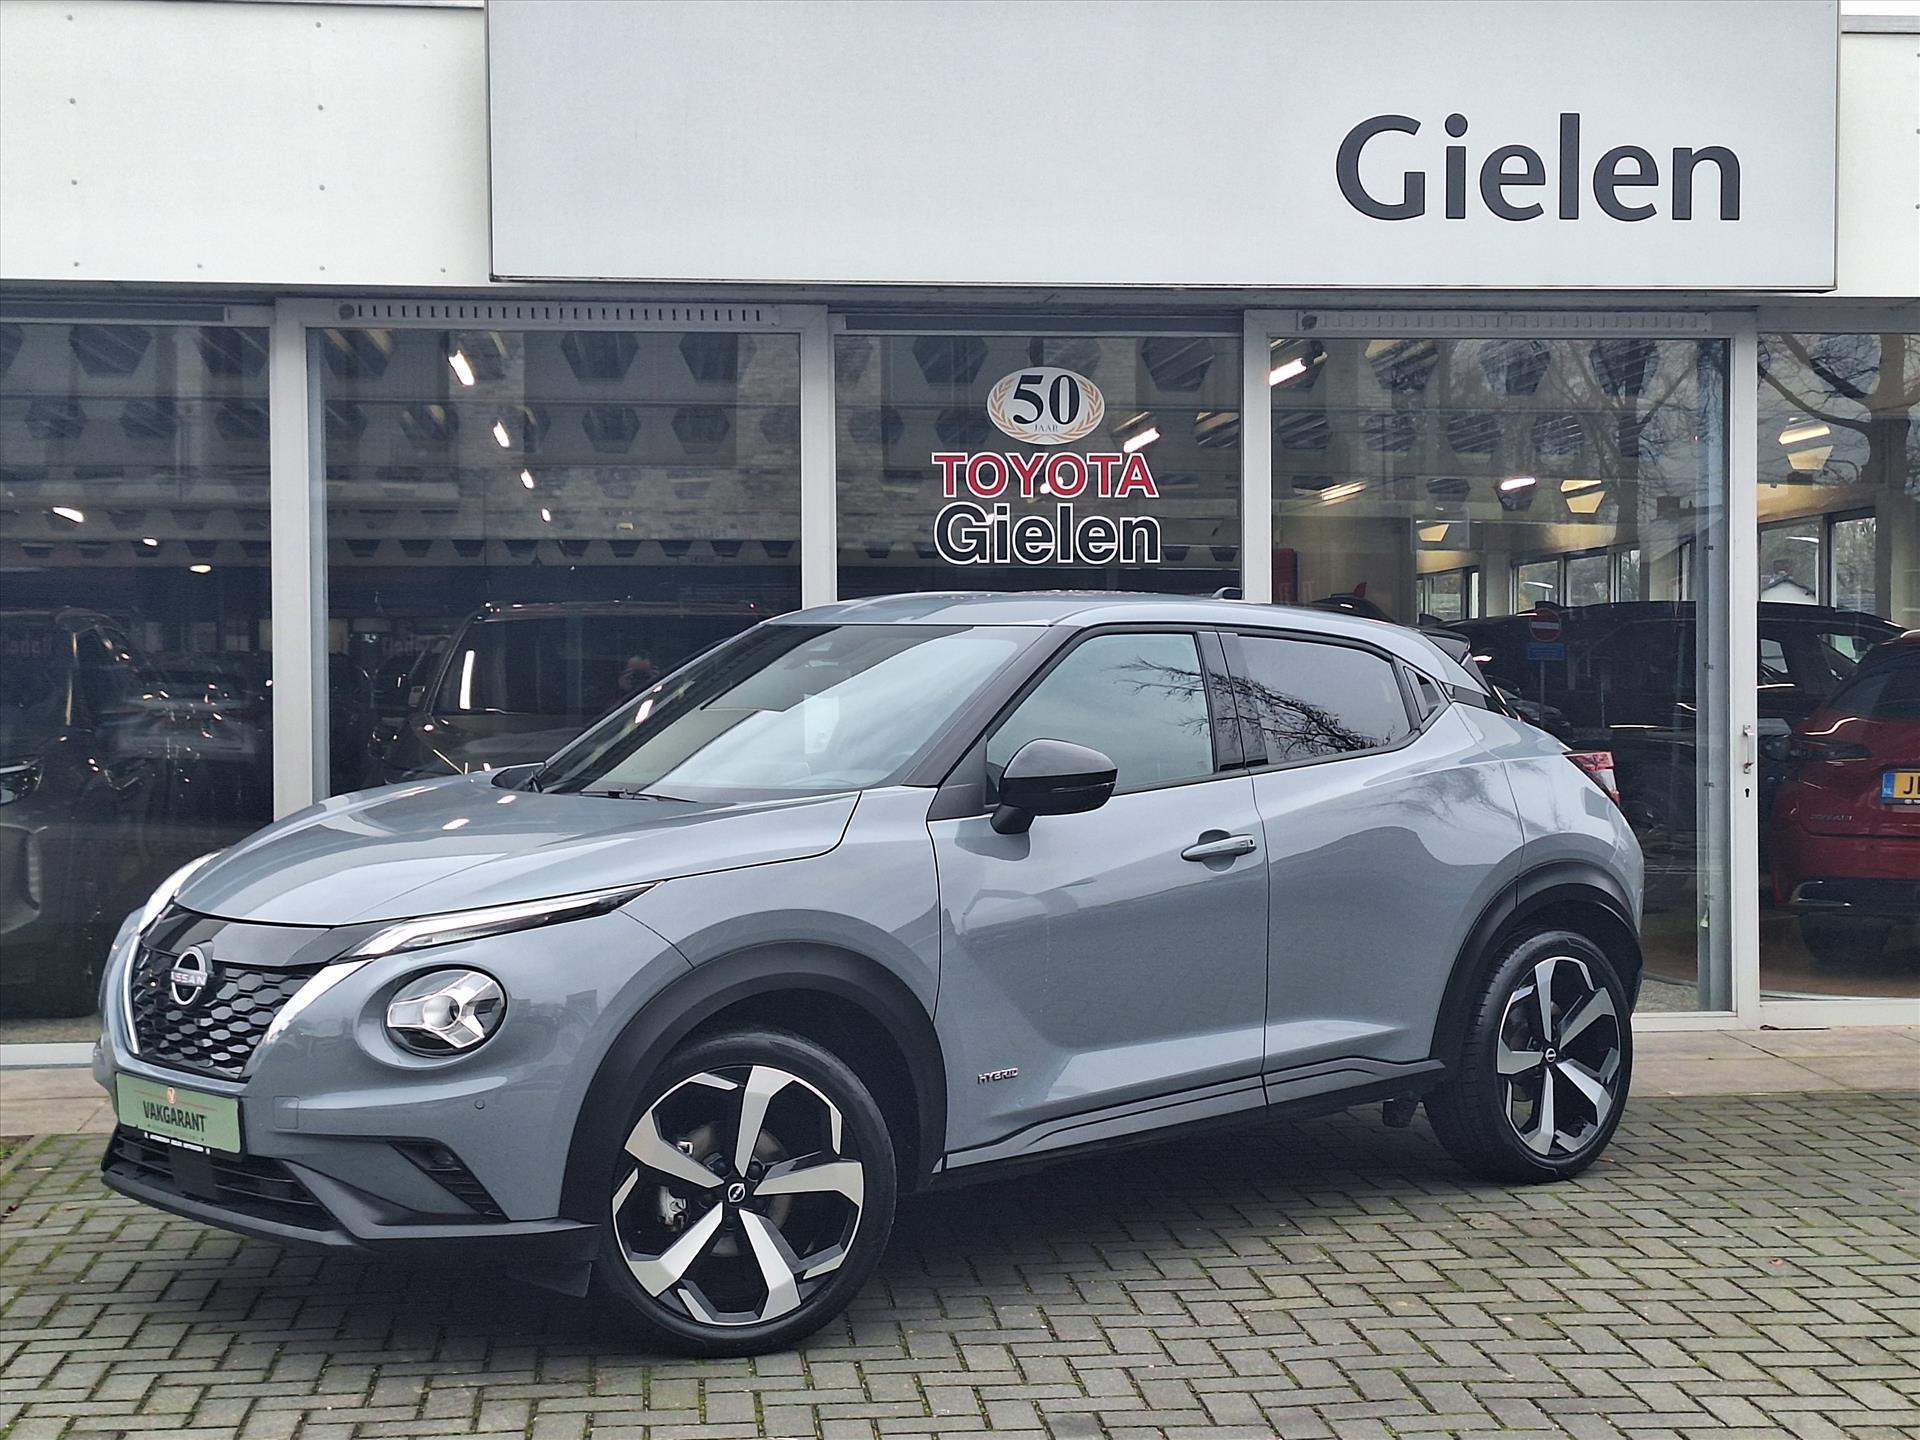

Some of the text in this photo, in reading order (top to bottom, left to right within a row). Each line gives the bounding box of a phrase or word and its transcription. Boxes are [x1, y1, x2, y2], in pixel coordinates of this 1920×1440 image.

[1337, 113, 1741, 222] Gielen
[1013, 374, 1081, 425] 50
[932, 452, 1160, 498] TOYOTA
[934, 501, 1161, 565] Gielen
[170, 970, 207, 986] ISSAN
[142, 1100, 207, 1133] VAKGARANT
